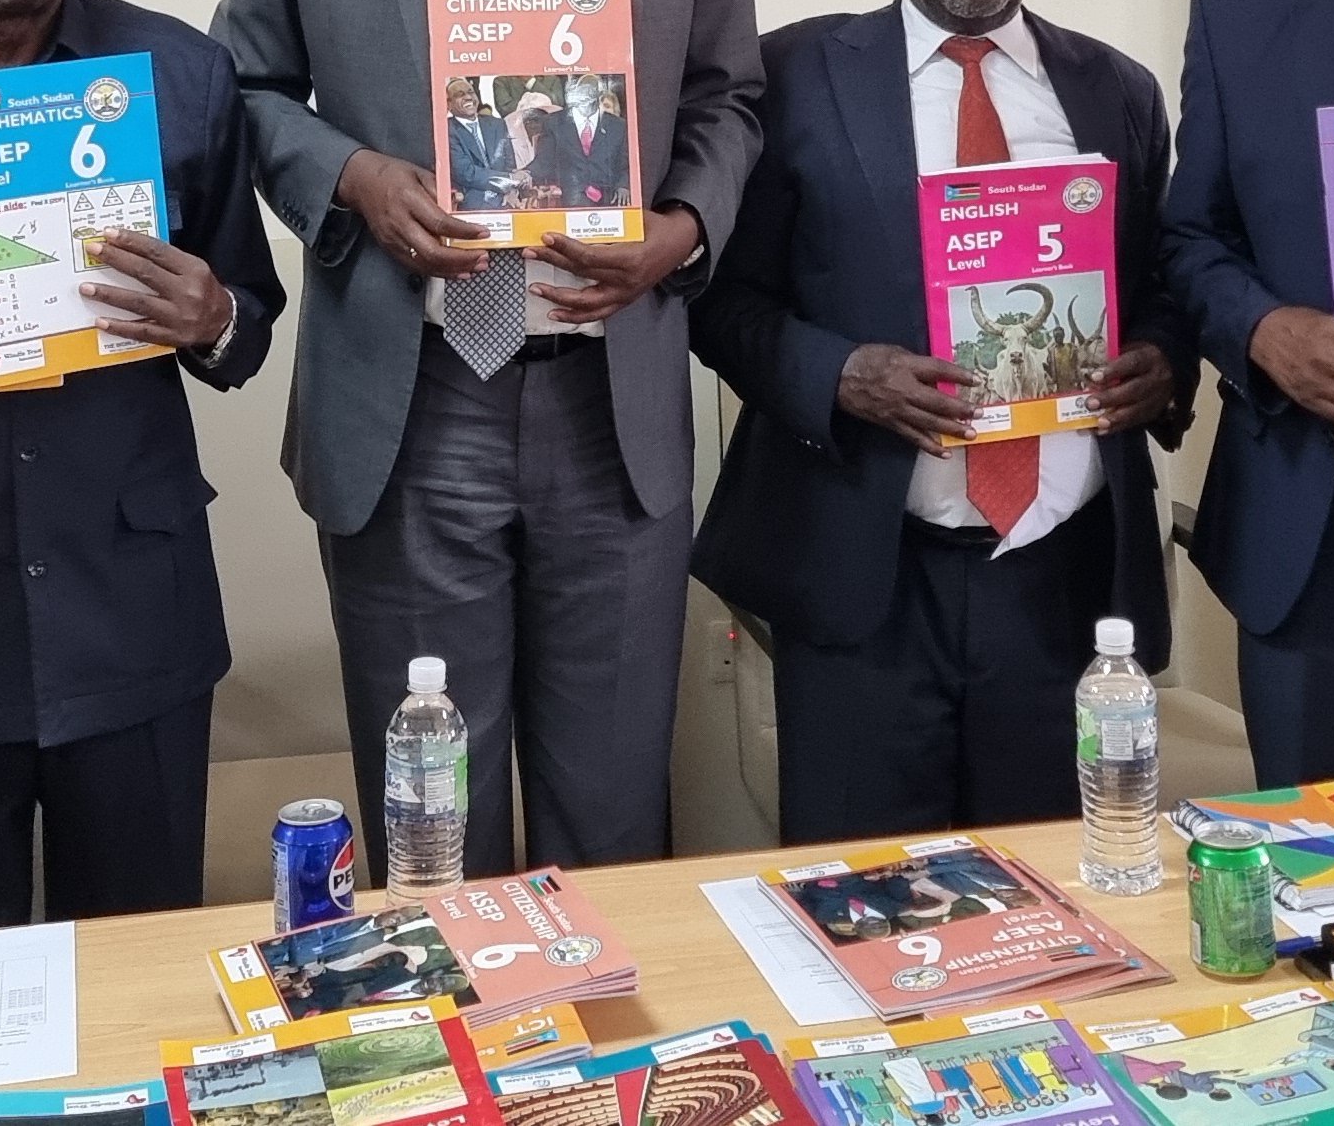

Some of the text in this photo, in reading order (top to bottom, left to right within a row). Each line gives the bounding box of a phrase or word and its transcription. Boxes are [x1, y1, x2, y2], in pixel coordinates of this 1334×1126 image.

[448, 13, 584, 66] ASEP 6
[449, 48, 492, 64] Level
[7, 92, 75, 108] South Sudan
[70, 123, 106, 179] 6
[987, 183, 1047, 195] South Sudan
[940, 202, 1019, 222] ENGLISH
[946, 223, 1065, 263] ASEP 5
[947, 255, 986, 272] Level
[333, 874, 354, 890] PE
[440, 895, 468, 920] Level
[465, 890, 506, 922] ASEP
[501, 881, 559, 940] CITIZENSHIP
[1003, 909, 1055, 925] Level
[992, 920, 1064, 942] ASEP
[471, 943, 541, 969] 6
[897, 934, 943, 966] 6
[945, 934, 1083, 972] CITIZENSHIP
[513, 1015, 556, 1038] ICT
[1056, 1115, 1120, 1126] Lev
